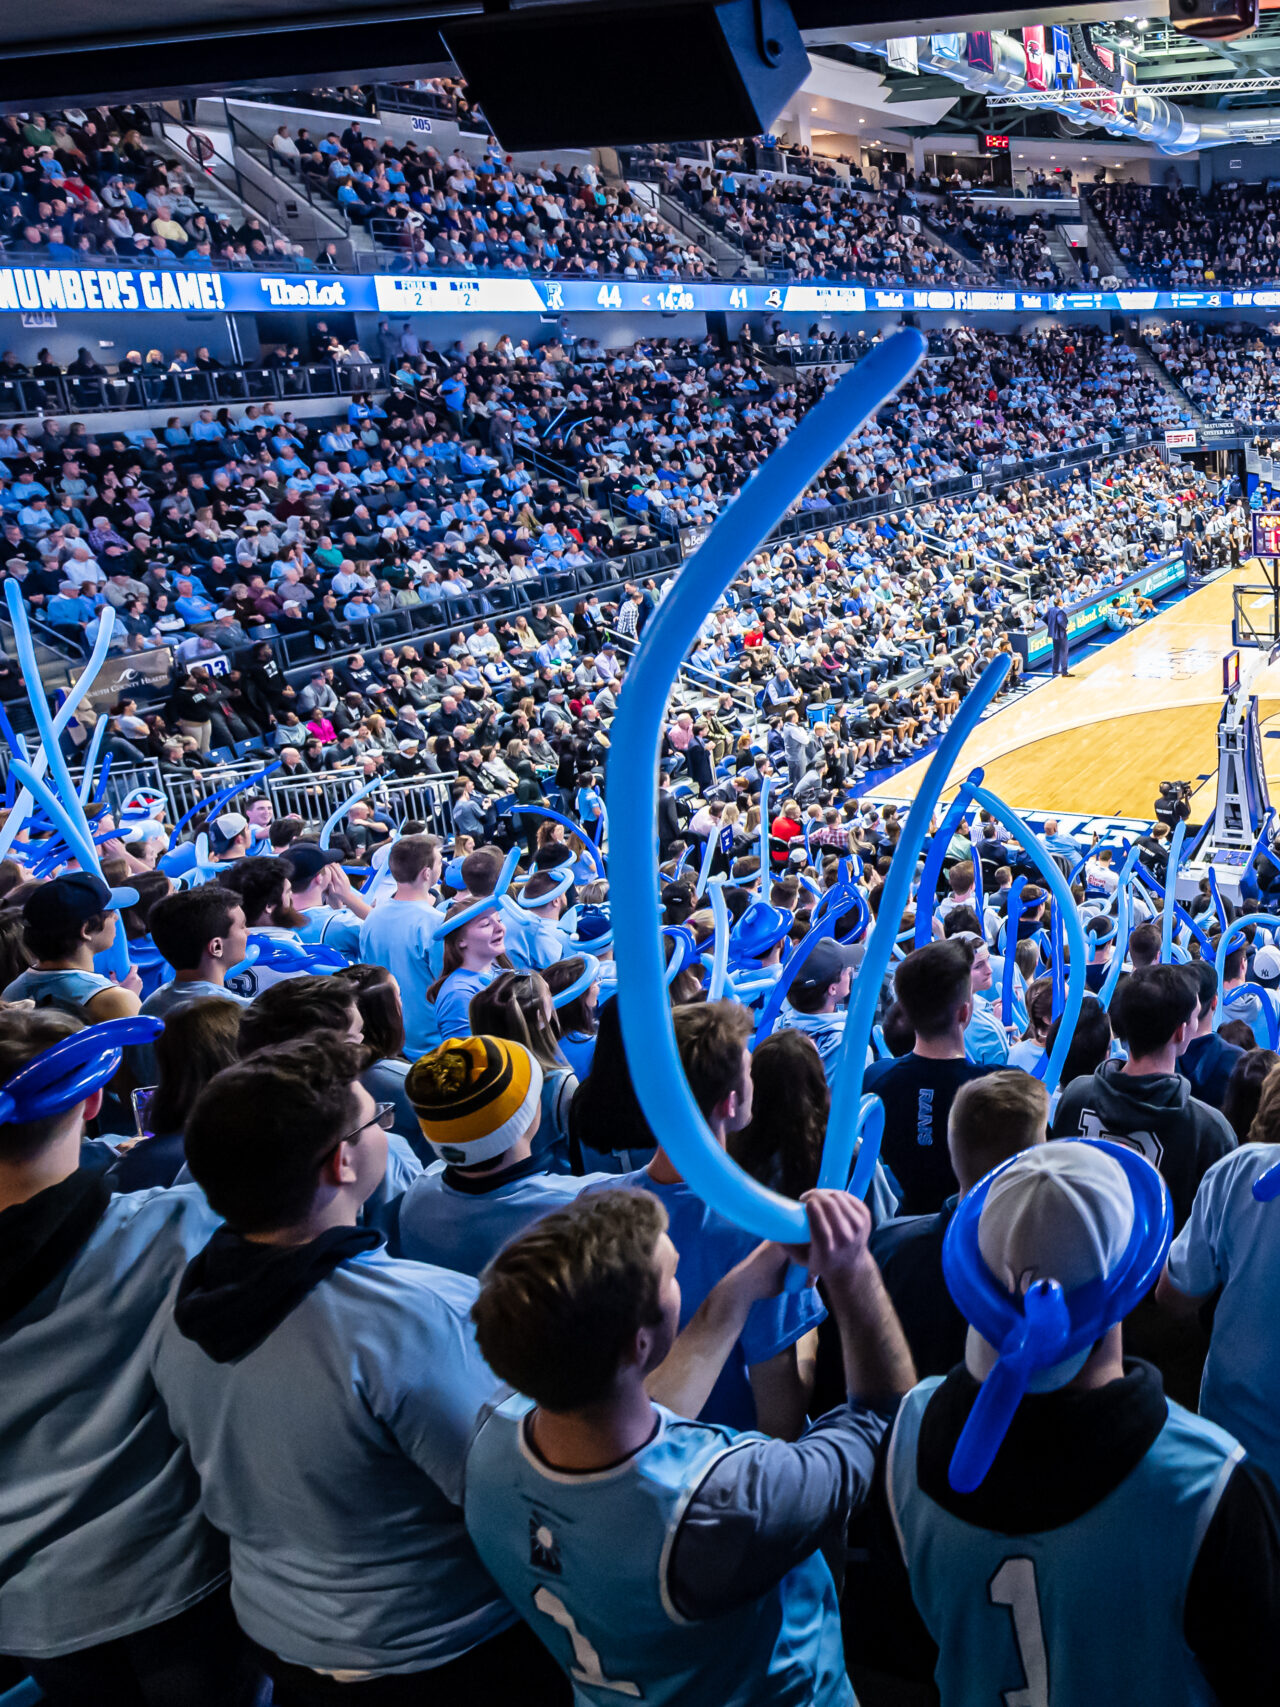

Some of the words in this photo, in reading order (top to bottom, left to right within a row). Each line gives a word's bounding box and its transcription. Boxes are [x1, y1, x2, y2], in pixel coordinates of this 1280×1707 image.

[411, 117, 431, 131] 305
[0, 268, 139, 309] NUMBERS
[139, 271, 226, 310] GAME!
[260, 278, 346, 306] TheLot
[597, 284, 622, 308] 44
[414, 292, 423, 306] 2
[463, 293, 471, 306] 2
[729, 288, 748, 309] 41
[1165, 434, 1195, 444] ESPN
[972, 475, 983, 487] 105
[111, 680, 140, 693] COUNTY
[917, 1088, 935, 1147] RAMS
[531, 1585, 643, 1699] 1
